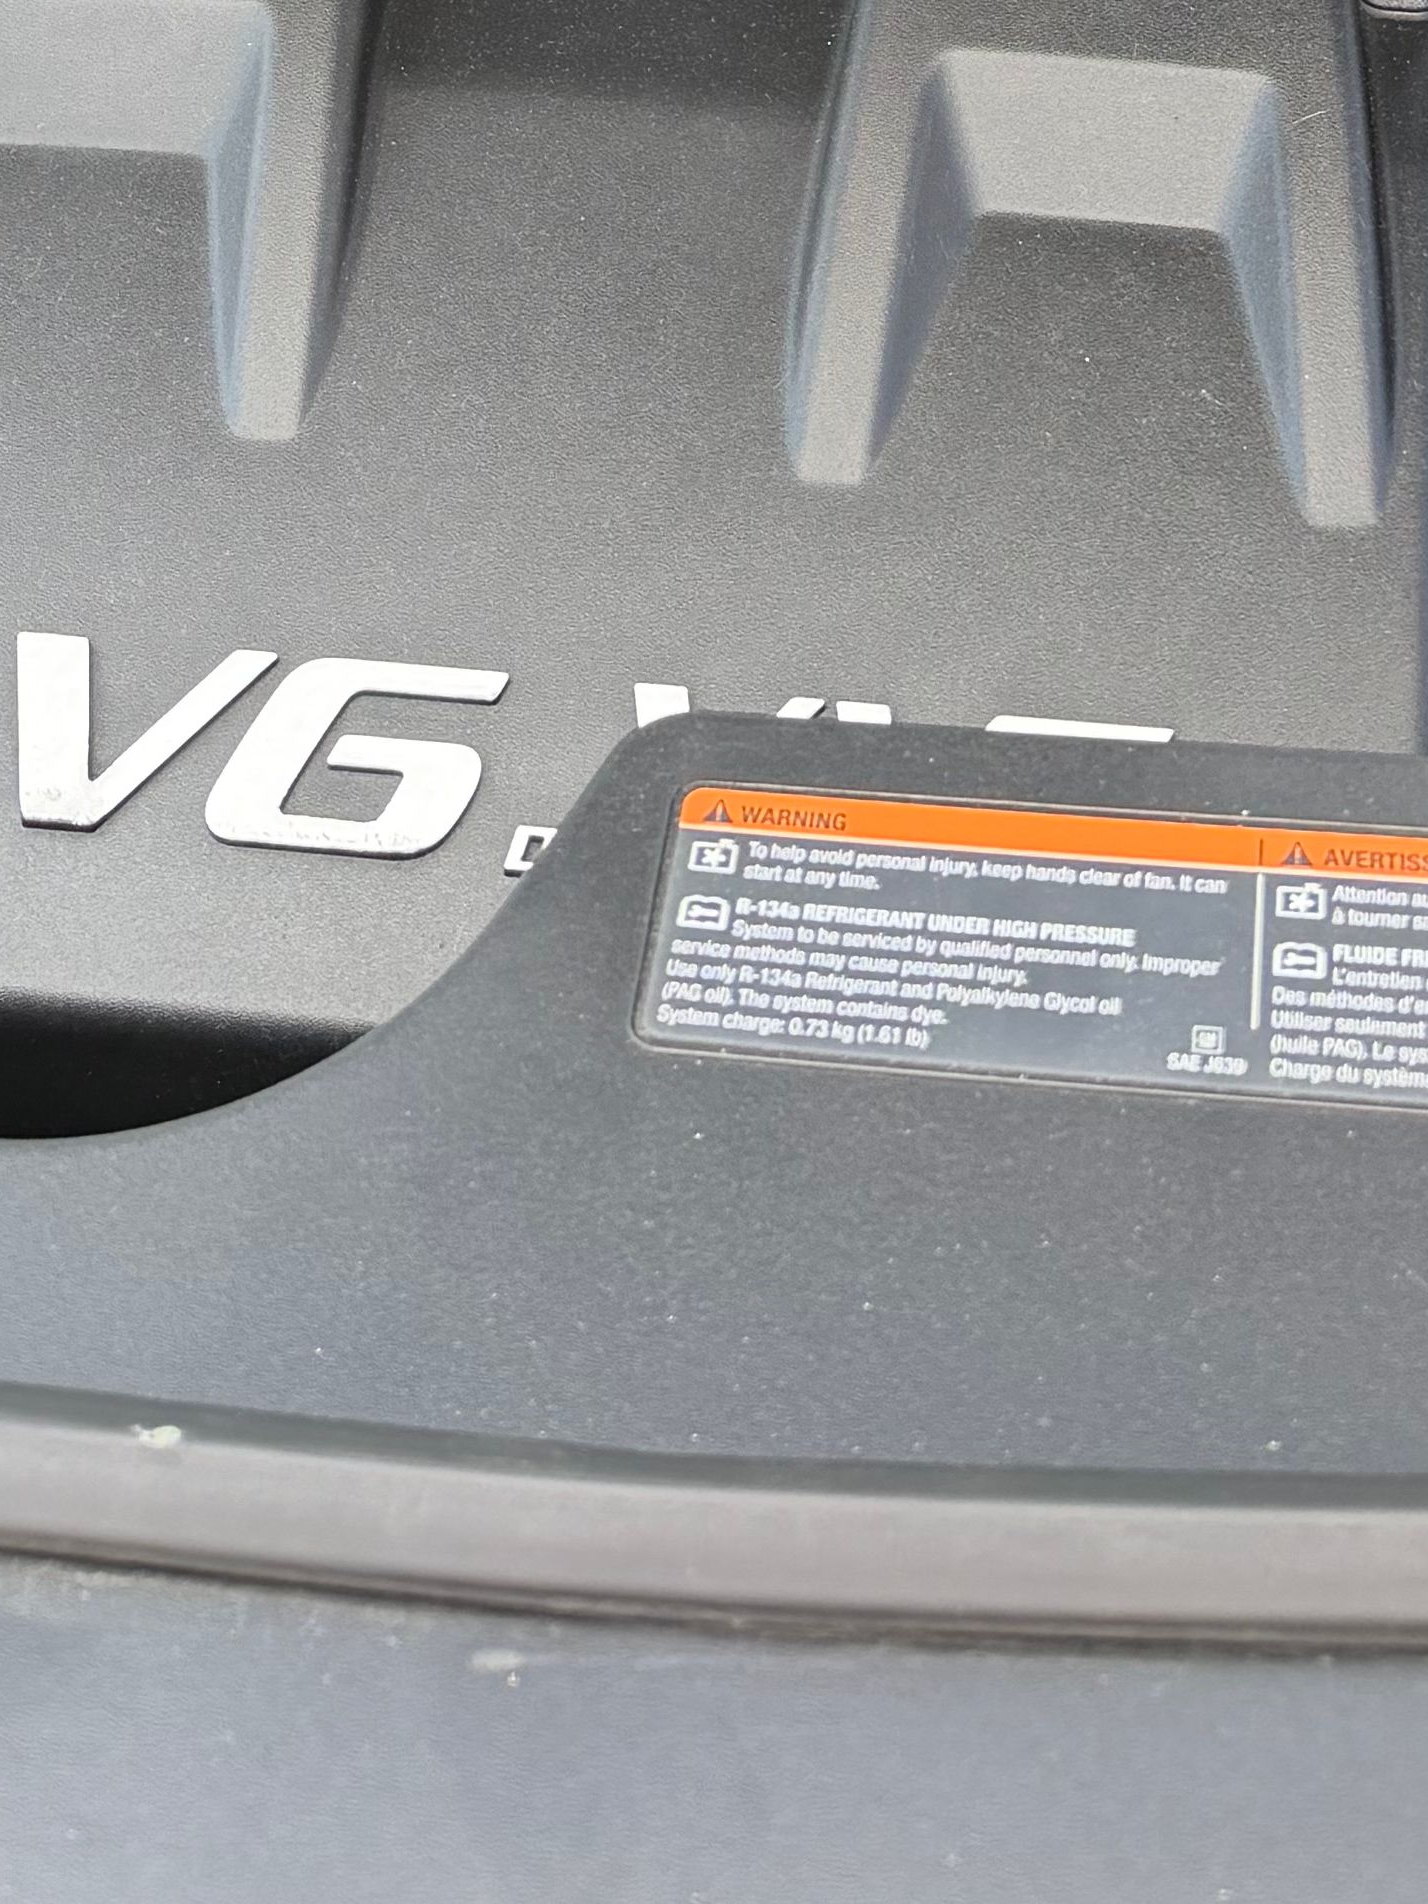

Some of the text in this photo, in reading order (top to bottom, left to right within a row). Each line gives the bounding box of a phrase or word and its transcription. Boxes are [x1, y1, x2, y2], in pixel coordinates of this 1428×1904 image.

[16, 631, 511, 859] V6
[741, 805, 847, 832] WARNING
[743, 864, 881, 890] start at any time.
[749, 841, 768, 858] To
[771, 843, 806, 864] help
[809, 849, 854, 866] avoid
[856, 854, 927, 872] personal
[981, 860, 1022, 882] keep
[1026, 864, 1077, 884] hands
[1080, 869, 1122, 887] clear
[1123, 870, 1142, 888] of
[1144, 872, 1176, 890] fan.
[1180, 874, 1194, 892] It
[1195, 879, 1228, 894] can
[1332, 886, 1409, 905] Attention
[735, 898, 1138, 947] R-134a REFRIGERANT UNDER HIGH PRESSURE
[1332, 906, 1345, 925] à
[1348, 909, 1410, 928] tourner
[671, 939, 732, 958] service
[734, 945, 807, 965] methods
[809, 952, 846, 971] may
[848, 955, 899, 973] cause
[901, 961, 974, 979] personal
[732, 919, 795, 941] System
[797, 927, 815, 943] to
[817, 927, 840, 945] be
[843, 932, 913, 951] serviced
[916, 935, 938, 955] by
[940, 940, 1013, 960] qualified
[1014, 947, 1097, 966] personnel
[1142, 955, 1223, 977] Improper
[1333, 944, 1399, 965] FLUIDE
[667, 959, 1123, 1015] Use only R-134a Refrigerant and Polyalkylene Glycol oil
[1272, 986, 1307, 1005] Des
[1310, 991, 1394, 1011] méthodes
[661, 981, 703, 1001] (PAG
[739, 988, 770, 1009] The
[773, 995, 834, 1014] system
[836, 1001, 908, 1021] contains
[657, 1003, 720, 1026] System
[722, 1012, 786, 1035] charge:
[789, 1017, 829, 1038] 0.73
[832, 1021, 855, 1044] kg
[857, 1025, 902, 1044] (1.61
[1271, 1010, 1333, 1031] Utiliser
[1335, 1017, 1426, 1038] seulement
[1167, 1052, 1201, 1073] SAE
[1372, 1041, 1397, 1061] Le
[1269, 1059, 1333, 1084] Charge
[1335, 1064, 1360, 1084] du
